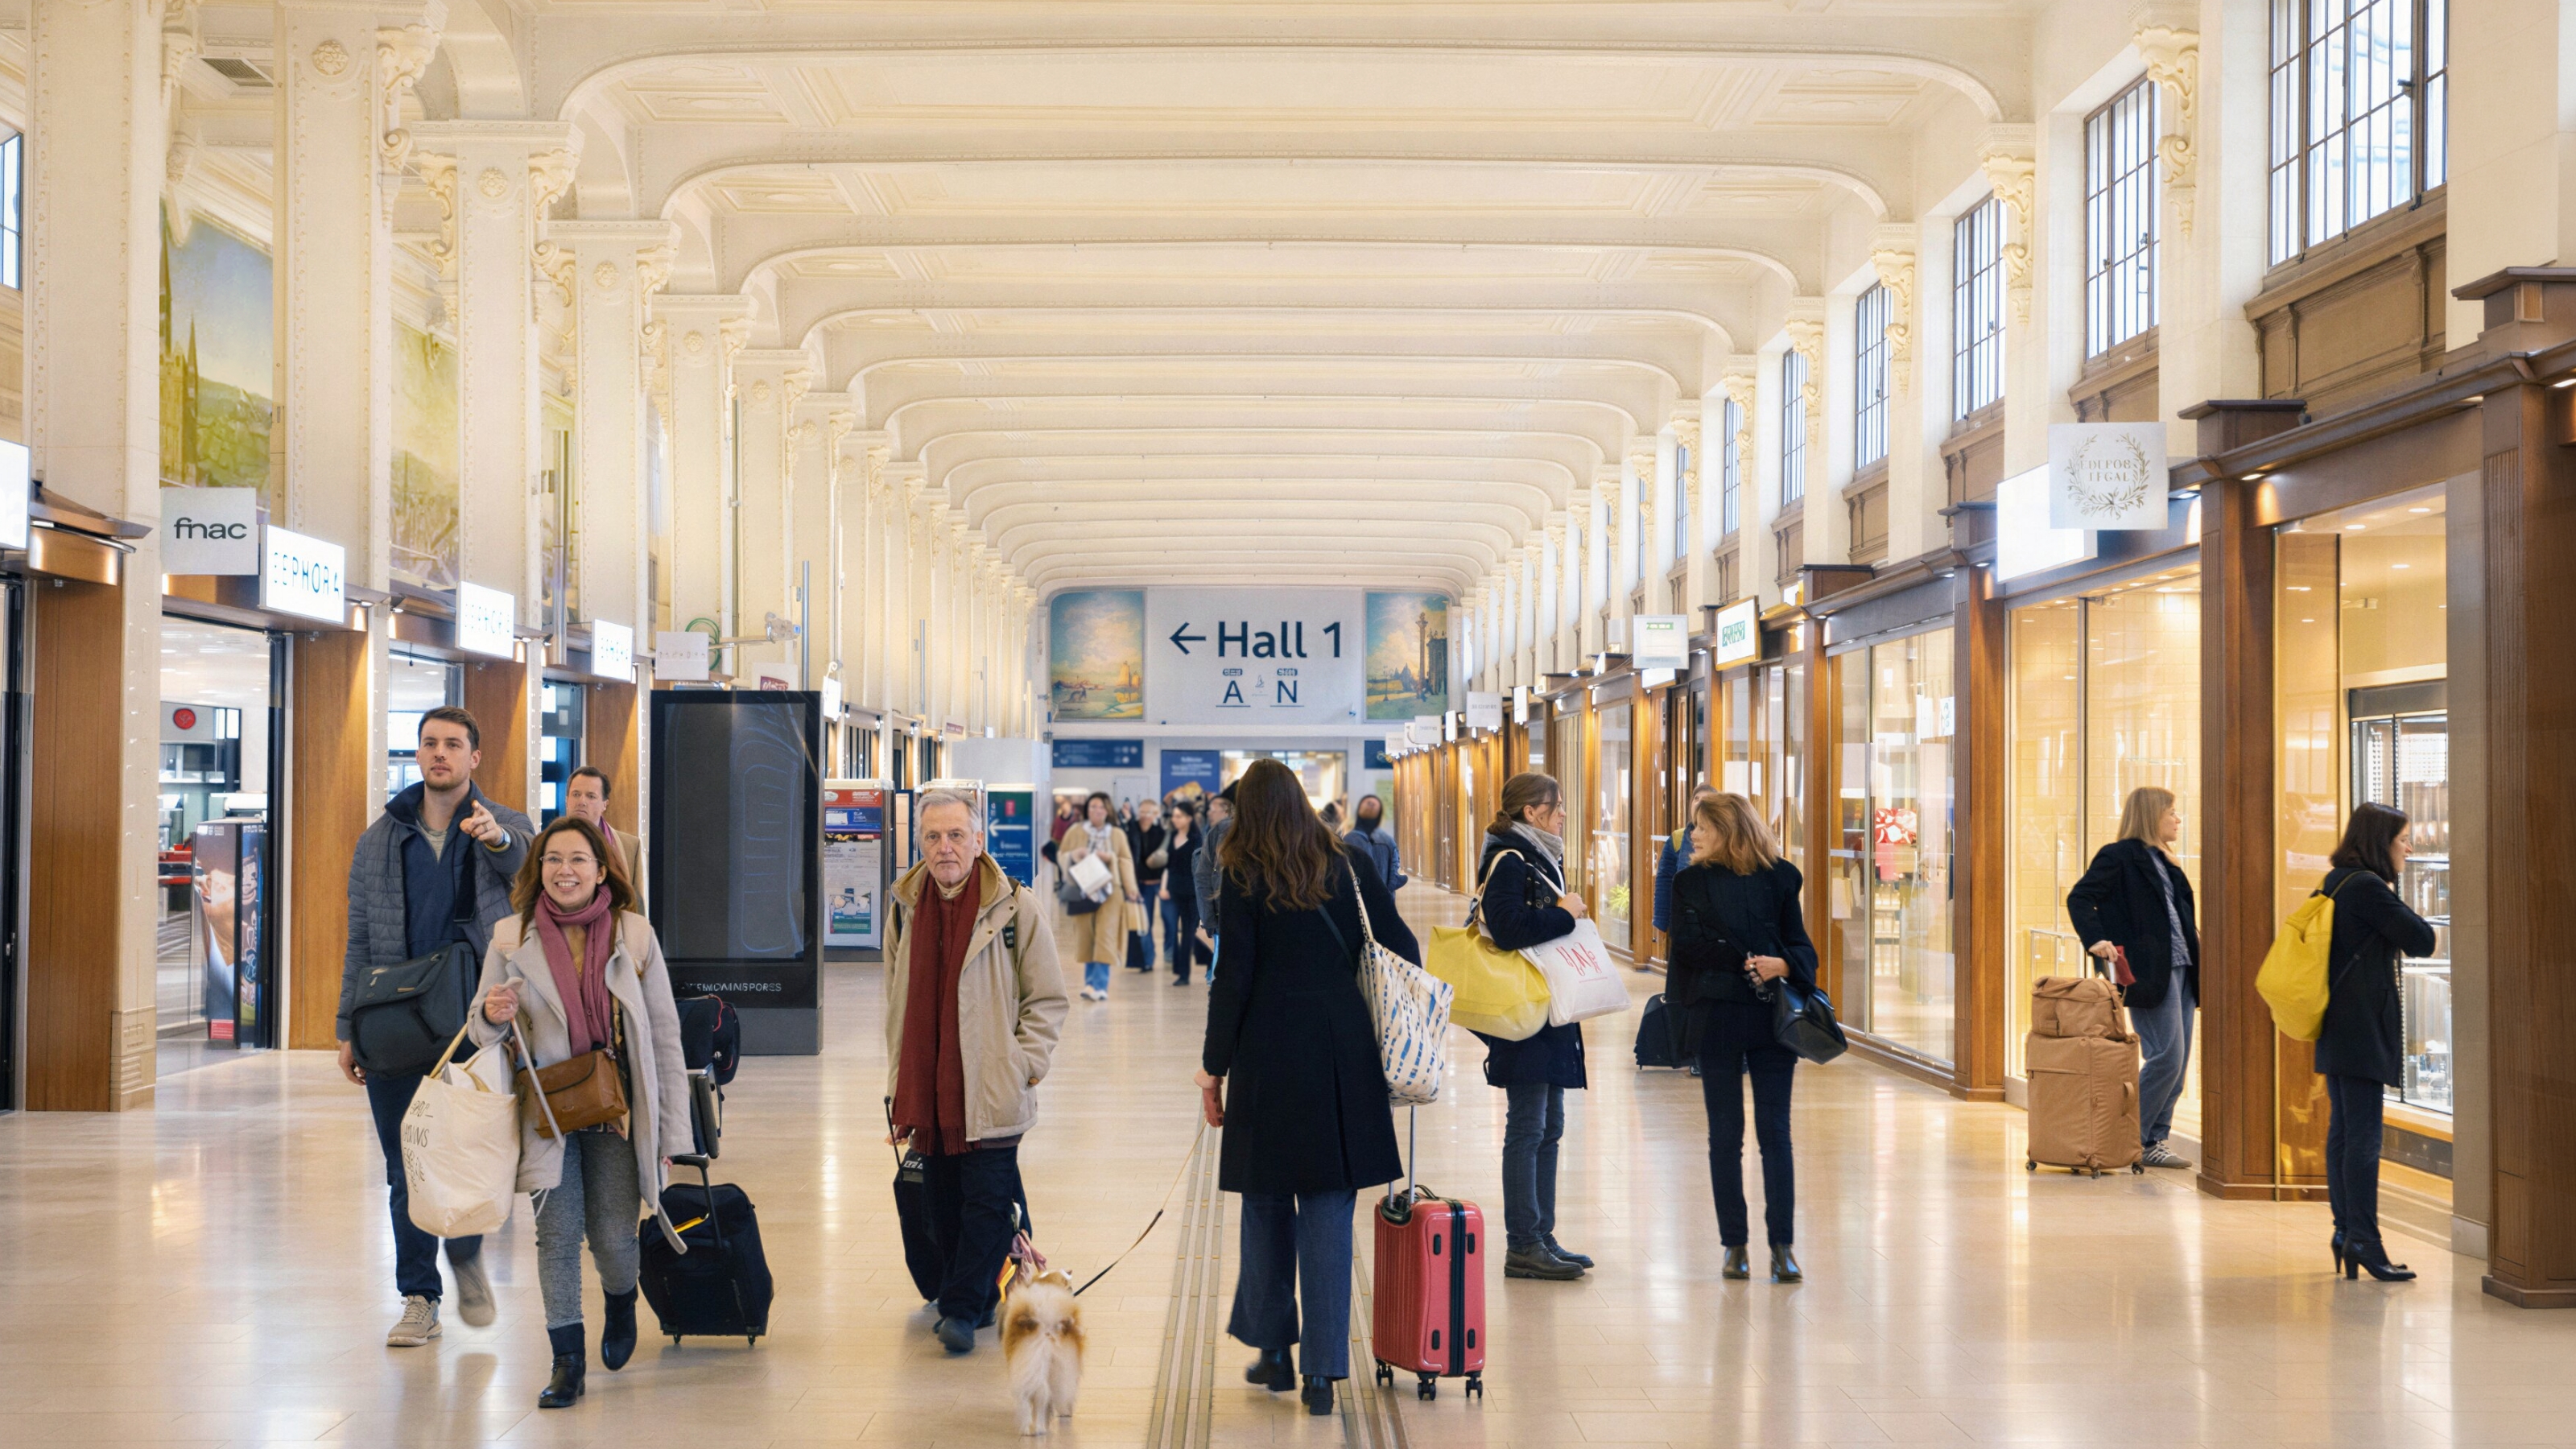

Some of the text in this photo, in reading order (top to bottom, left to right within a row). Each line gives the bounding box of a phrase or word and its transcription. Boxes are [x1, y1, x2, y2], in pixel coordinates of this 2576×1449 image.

[173, 517, 247, 539] fnac
[1218, 621, 1340, 658] Hall 1
[1223, 680, 1244, 703] A
[1277, 680, 1297, 703] N
